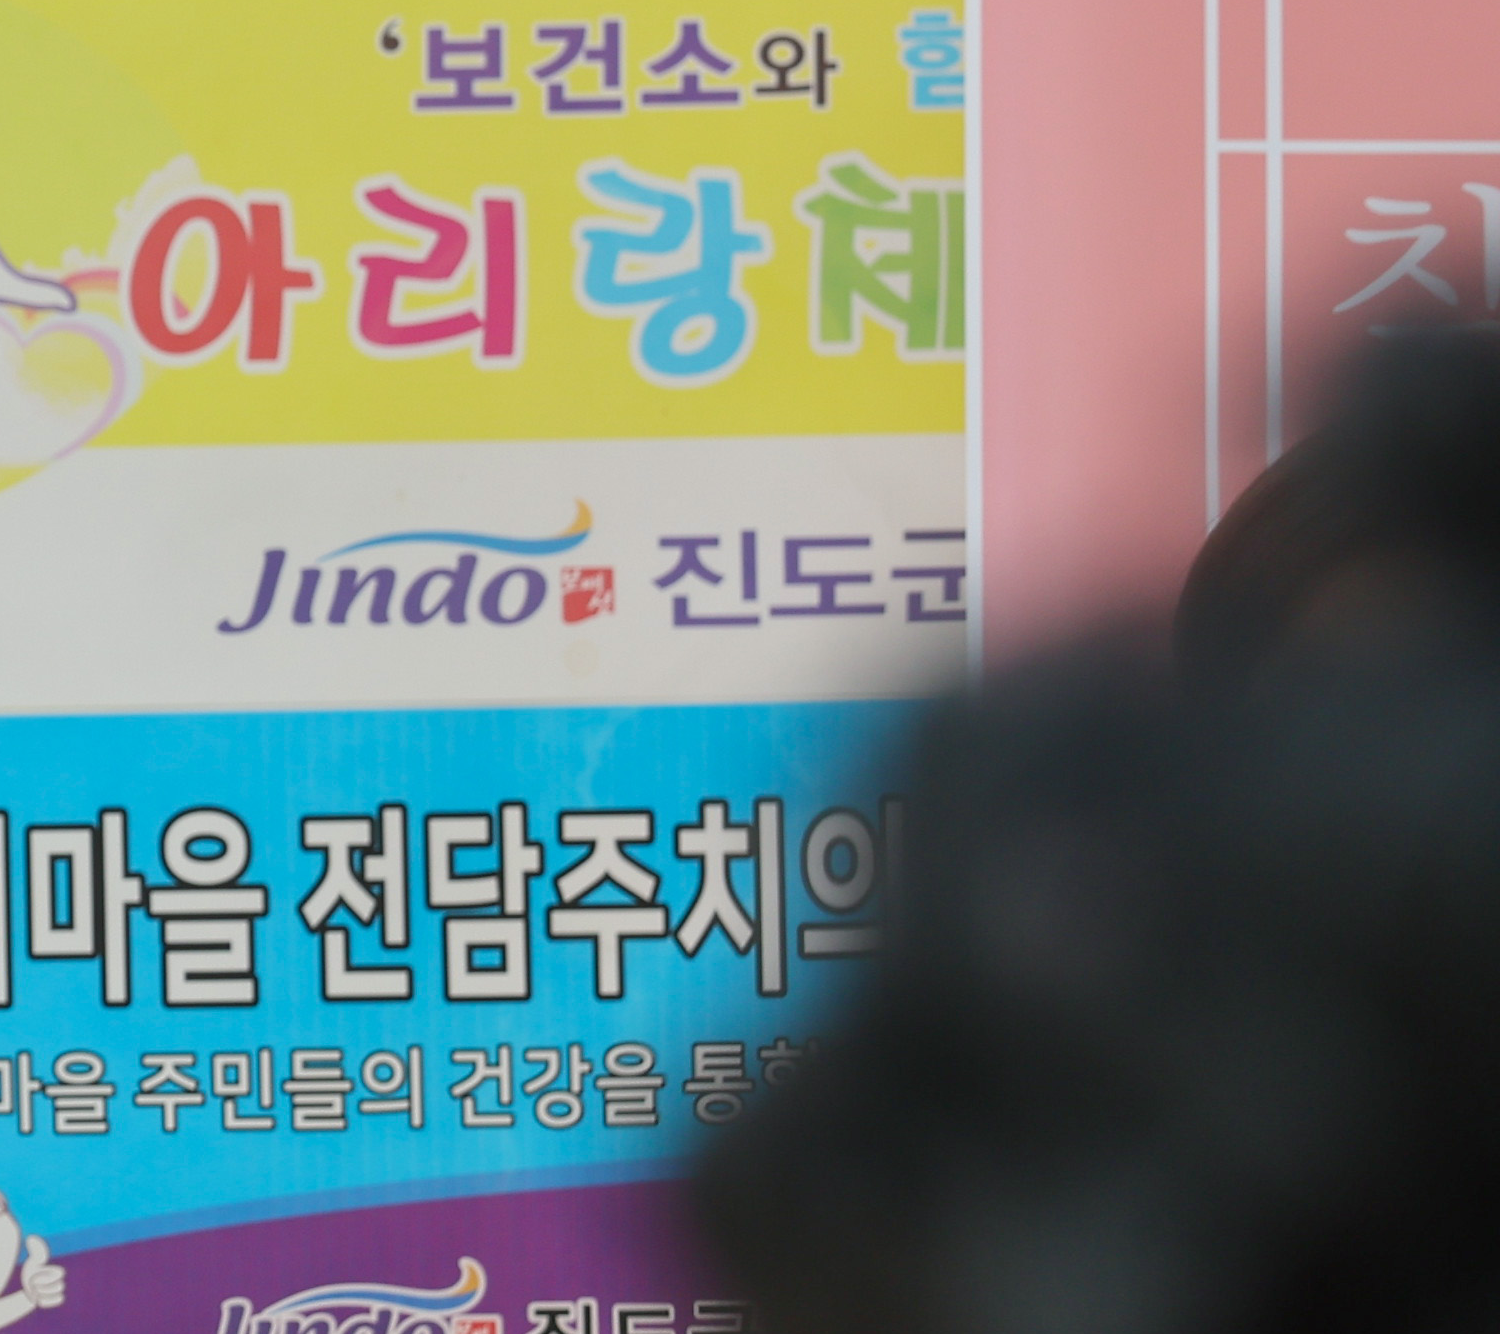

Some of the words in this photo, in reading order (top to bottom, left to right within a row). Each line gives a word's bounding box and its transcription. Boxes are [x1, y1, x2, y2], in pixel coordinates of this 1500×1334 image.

[217, 547, 547, 635] Jindo
[652, 529, 966, 628] 진도군
[297, 798, 908, 1005] 전담주치의
[134, 1045, 427, 1133] 주민들의
[447, 1043, 666, 1130] 건강을
